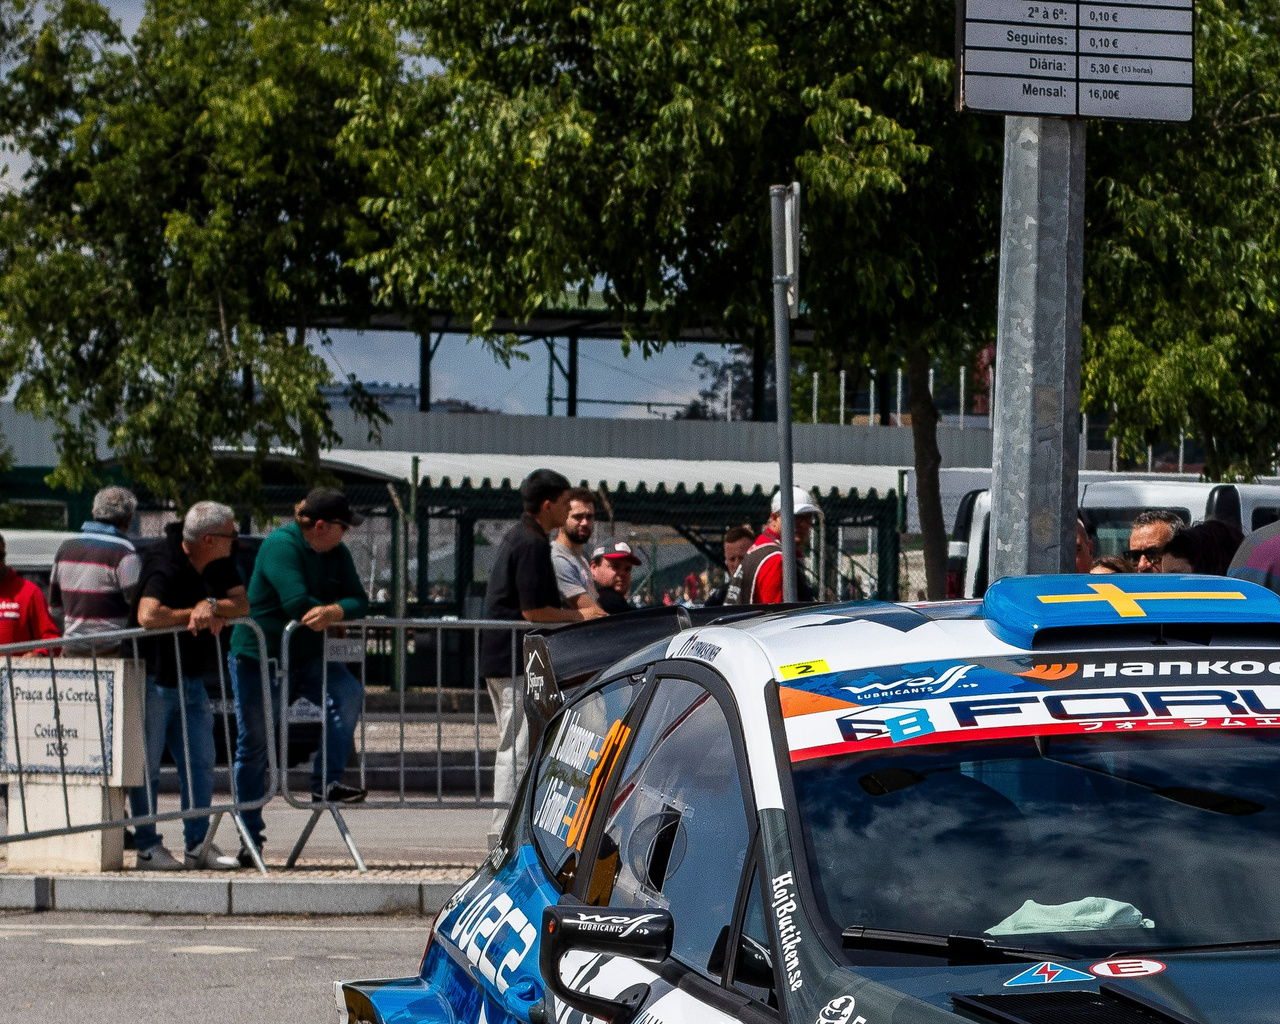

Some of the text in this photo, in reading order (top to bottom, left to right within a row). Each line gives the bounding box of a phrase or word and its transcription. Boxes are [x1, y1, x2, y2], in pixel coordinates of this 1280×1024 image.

[1089, 11, 1118, 22] 0,10 €
[1006, 30, 1068, 47] Seguintes:
[1089, 37, 1118, 49] 0,10 €
[1029, 57, 1067, 71] Diária:
[1090, 63, 1110, 74] 5,30
[1113, 63, 1119, 74] €
[1022, 83, 1067, 98] Mensal:
[795, 664, 815, 675] 2
[14, 686, 43, 702] Praça
[45, 687, 64, 701] ds
[857, 686, 934, 700] LUBRICANTS
[578, 923, 624, 933] LUBRICANTS
[1107, 960, 1150, 977] E
